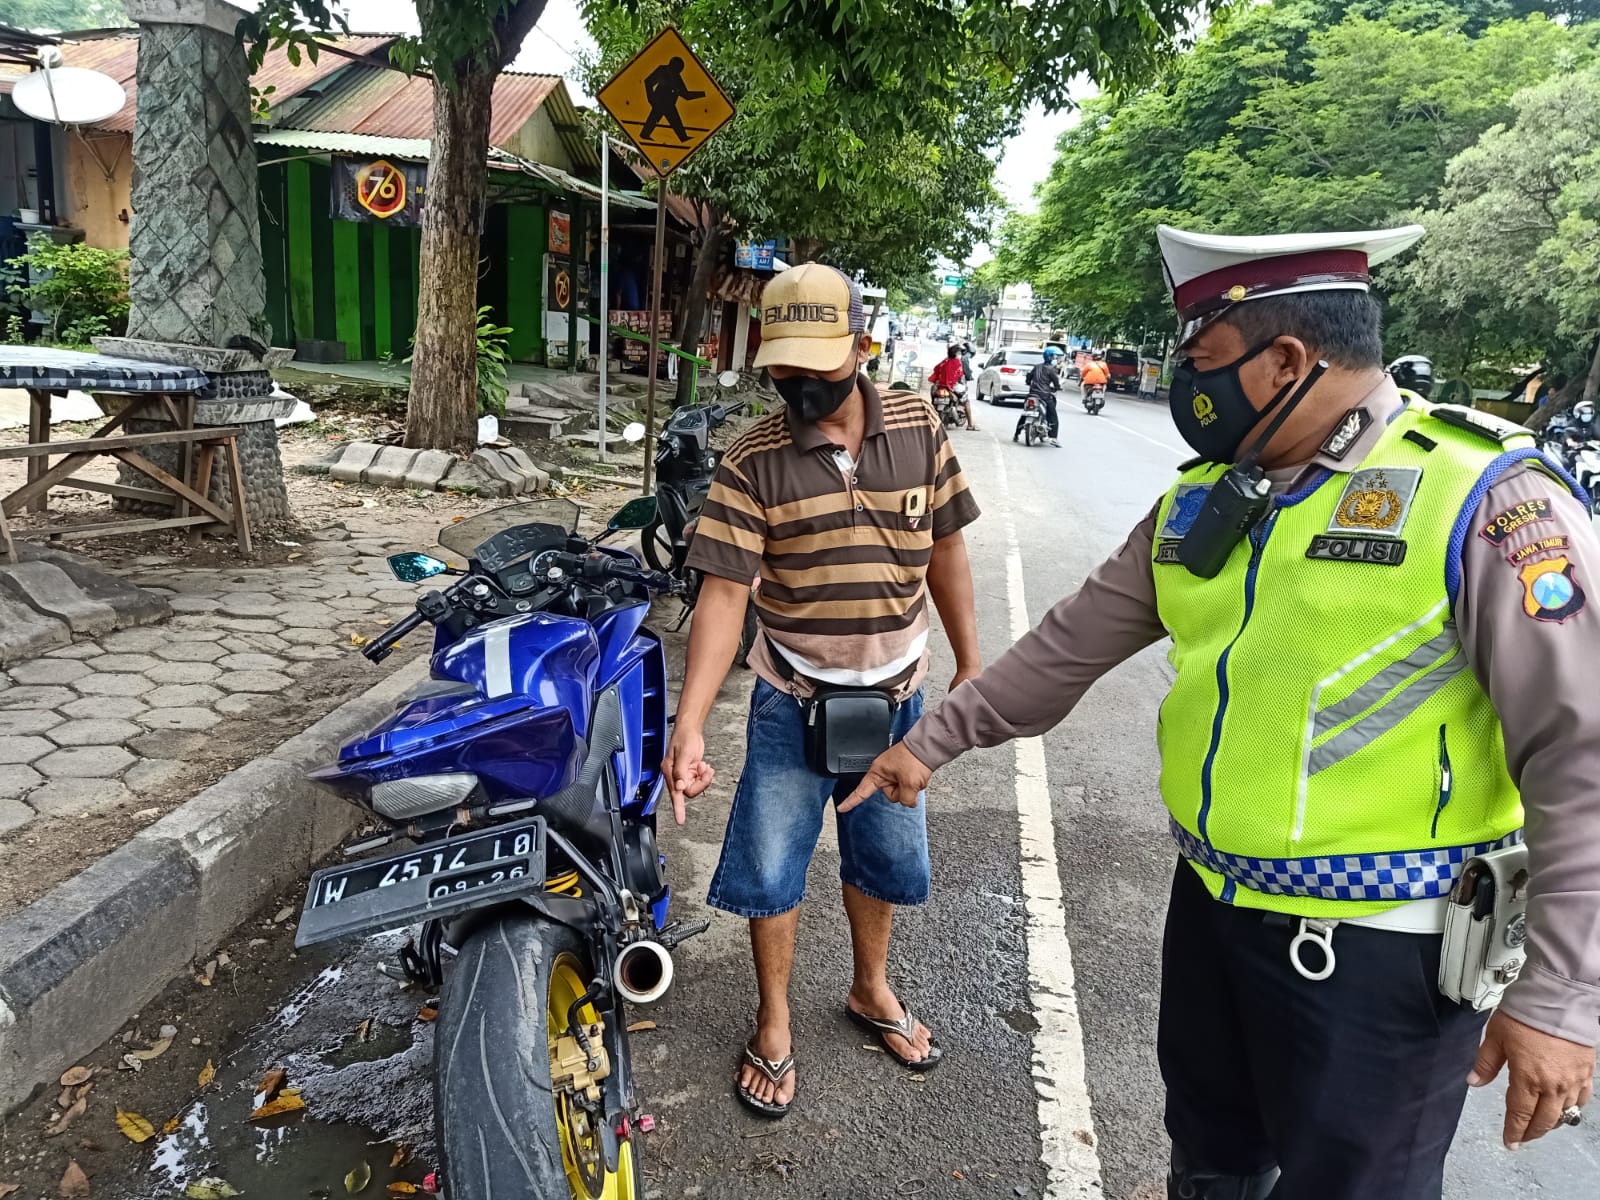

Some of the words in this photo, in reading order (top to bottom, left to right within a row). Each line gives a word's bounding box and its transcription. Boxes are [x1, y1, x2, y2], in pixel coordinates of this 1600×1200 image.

[366, 169, 396, 204] 76
[1200, 412, 1218, 428] POLRI
[1486, 500, 1546, 536] POLRES
[1503, 511, 1540, 533] GRESIK
[1310, 539, 1403, 562] POLISI
[1516, 545, 1538, 560] JAWA
[1540, 538, 1563, 549] TIMUR
[324, 877, 348, 905] W
